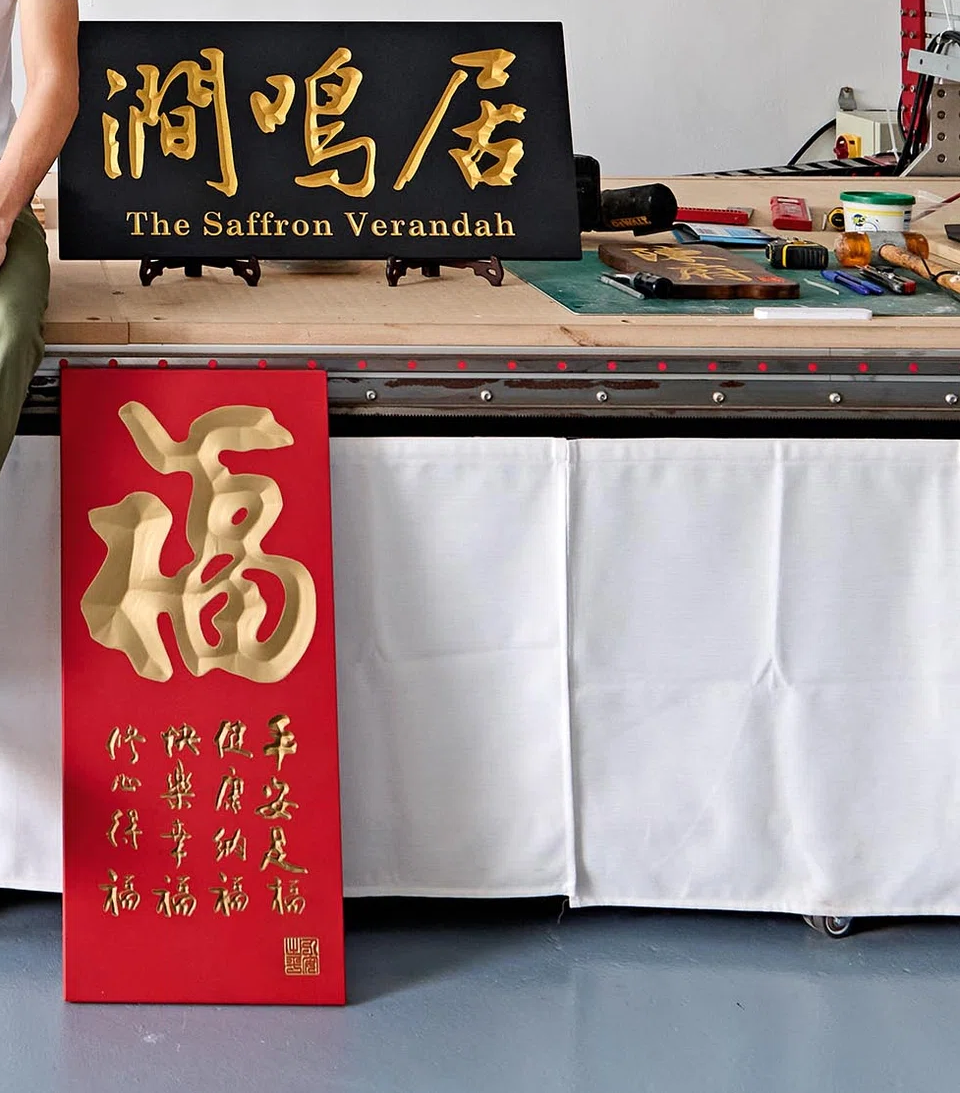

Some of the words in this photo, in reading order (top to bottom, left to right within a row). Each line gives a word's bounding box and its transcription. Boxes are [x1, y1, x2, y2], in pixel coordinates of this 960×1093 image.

[126, 211, 191, 237] The
[203, 211, 334, 237] Saffron
[344, 211, 516, 237] Verandah
[80, 400, 317, 683] 福
